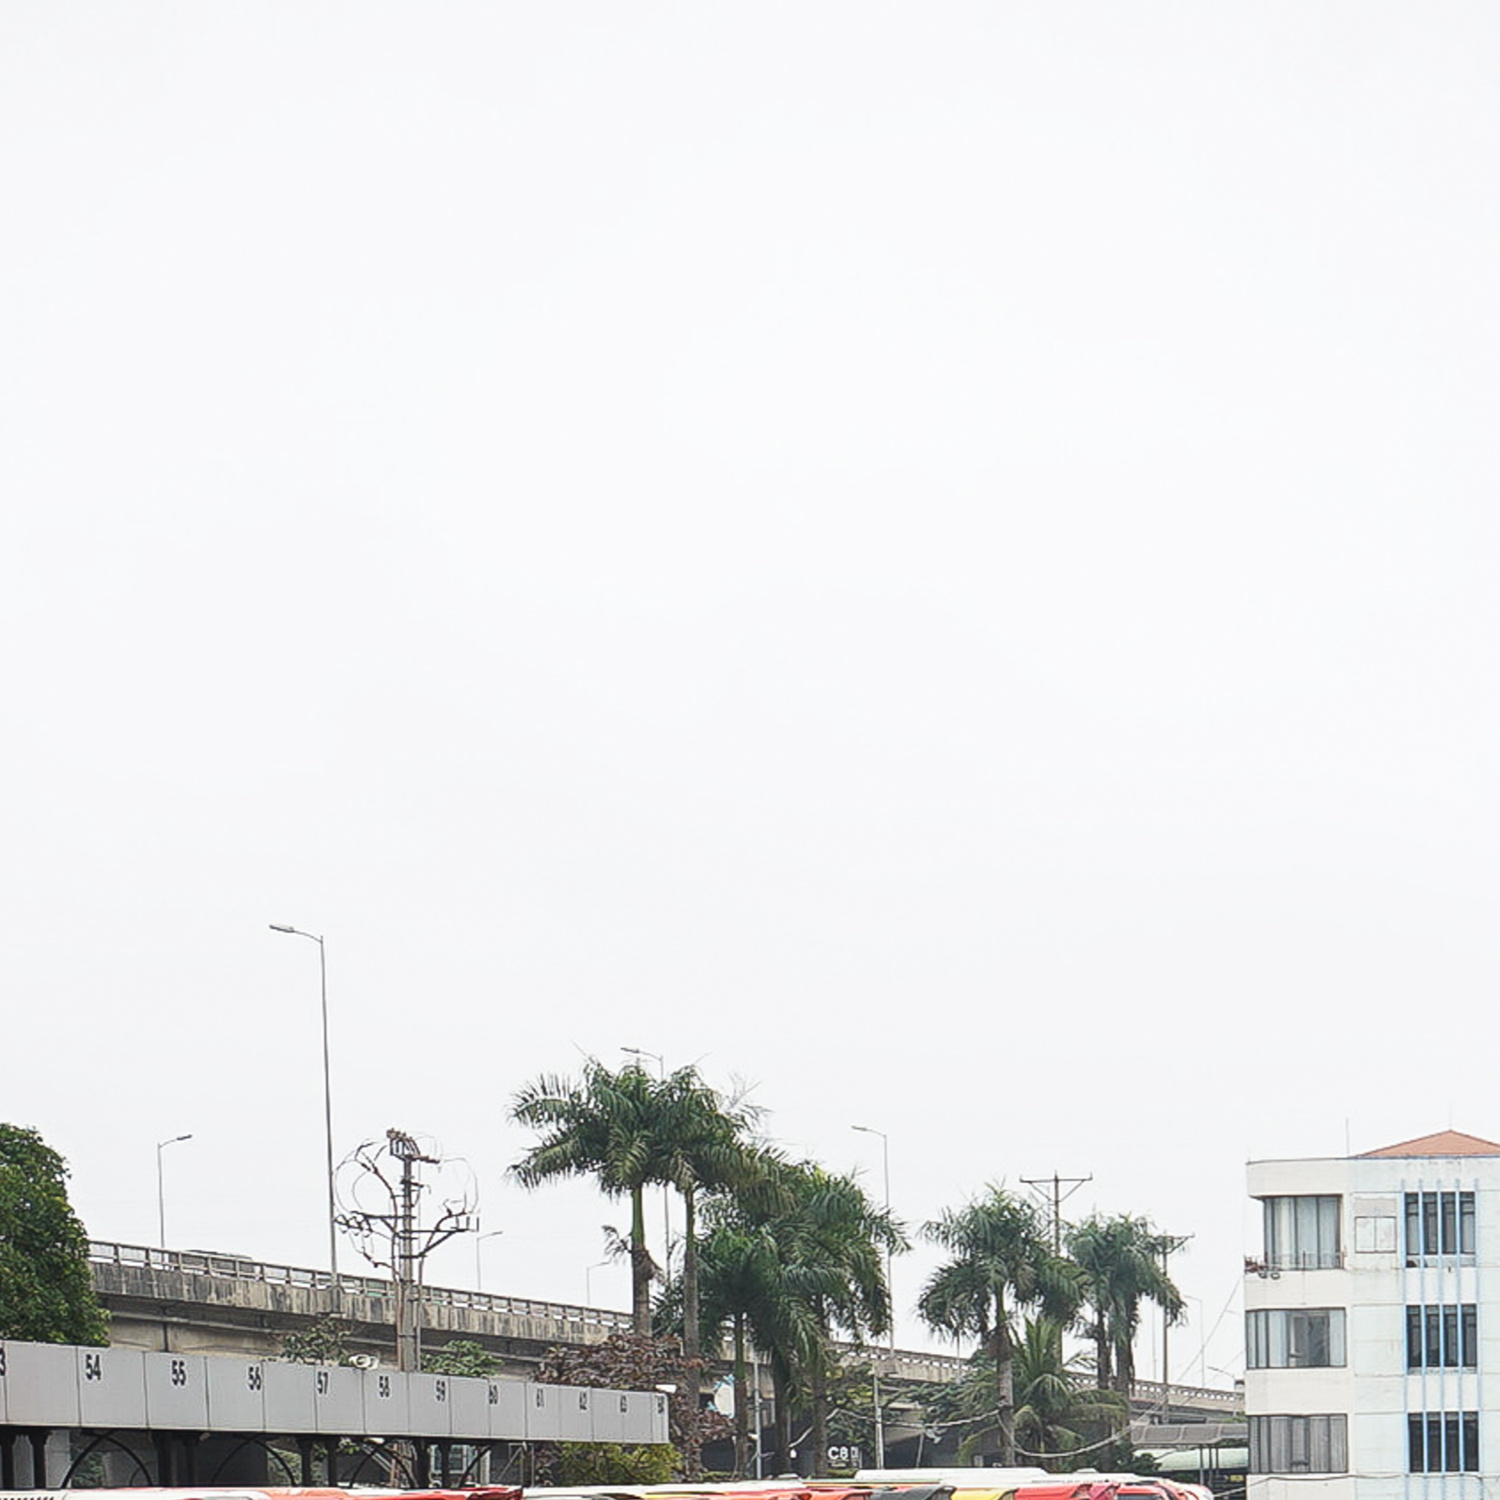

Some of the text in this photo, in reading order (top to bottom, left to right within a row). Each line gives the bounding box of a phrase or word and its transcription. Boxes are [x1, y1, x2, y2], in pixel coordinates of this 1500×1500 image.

[86, 1354, 101, 1380] 54
[171, 1360, 186, 1386] 55
[249, 1366, 261, 1390] 56
[317, 1371, 328, 1394] 57
[379, 1376, 390, 1397] 58
[436, 1379, 446, 1402] 59
[488, 1384, 498, 1405] 60
